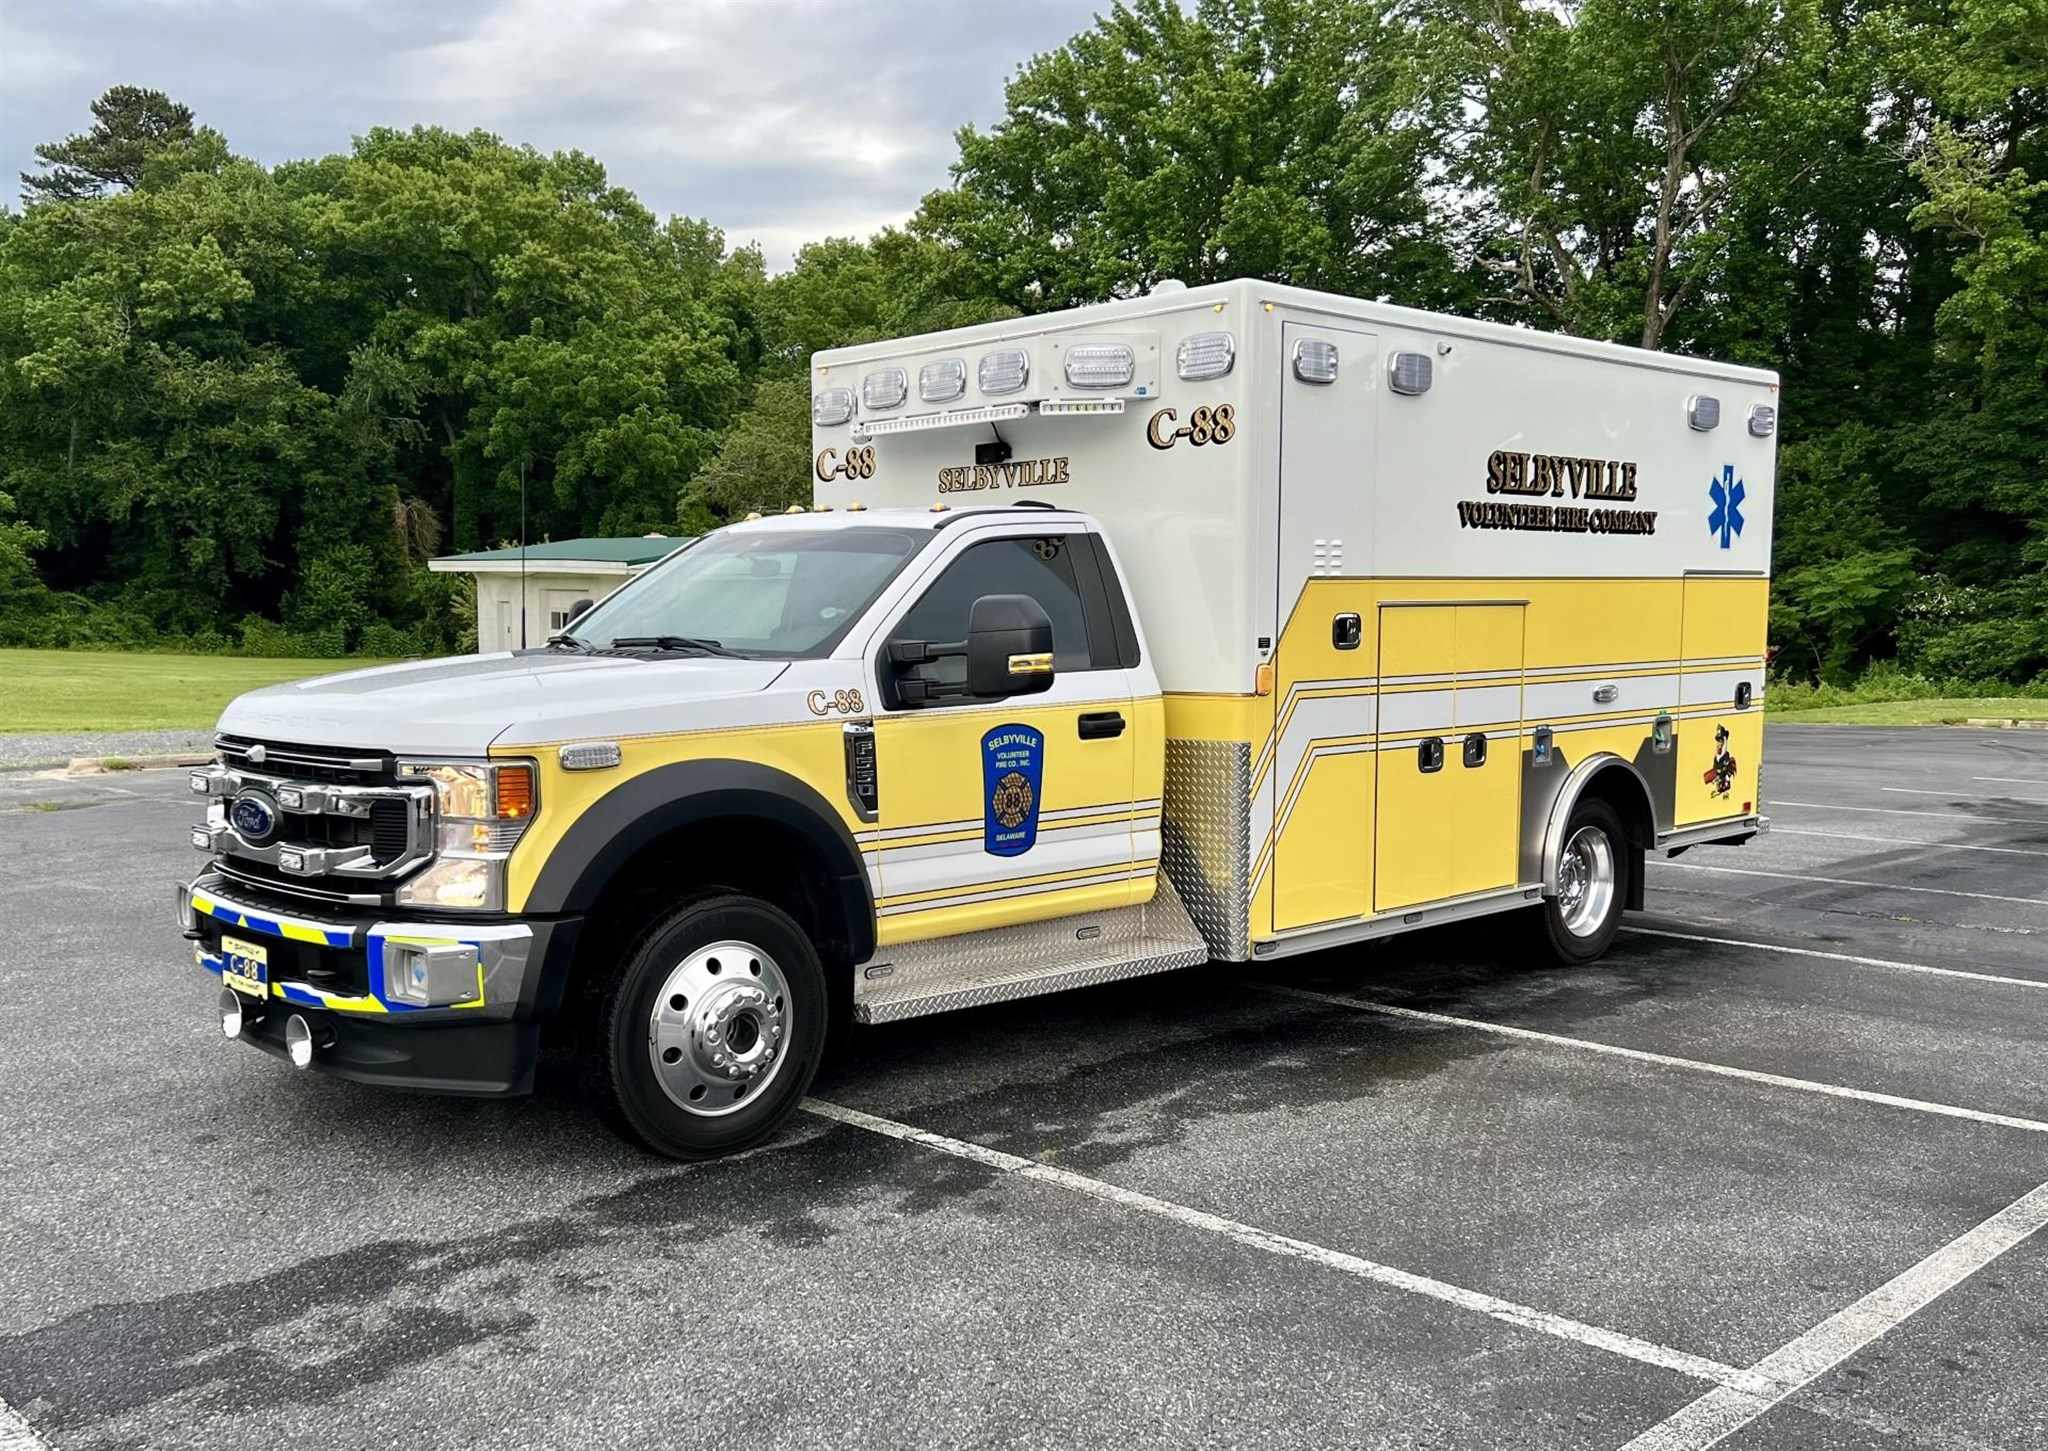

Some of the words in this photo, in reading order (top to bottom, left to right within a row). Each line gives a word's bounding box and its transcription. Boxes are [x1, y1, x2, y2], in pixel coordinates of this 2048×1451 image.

[1147, 404, 1235, 450] C-88
[816, 445, 876, 482] C-88
[939, 457, 1069, 493] SELBYVILLE
[1486, 450, 1638, 501] SELBYVILLE
[1457, 501, 1554, 532] VOLUNTEER
[1554, 507, 1589, 533] FIRE
[1589, 509, 1658, 535] COMPANY
[807, 688, 864, 715] C-88
[988, 734, 1037, 750] SELBYVILLE
[996, 750, 1029, 759] VOLUNTEER
[1006, 793, 1020, 809] 88
[237, 804, 262, 829] Ford
[996, 831, 1025, 841] DELAWARE
[230, 953, 258, 980] C-88
